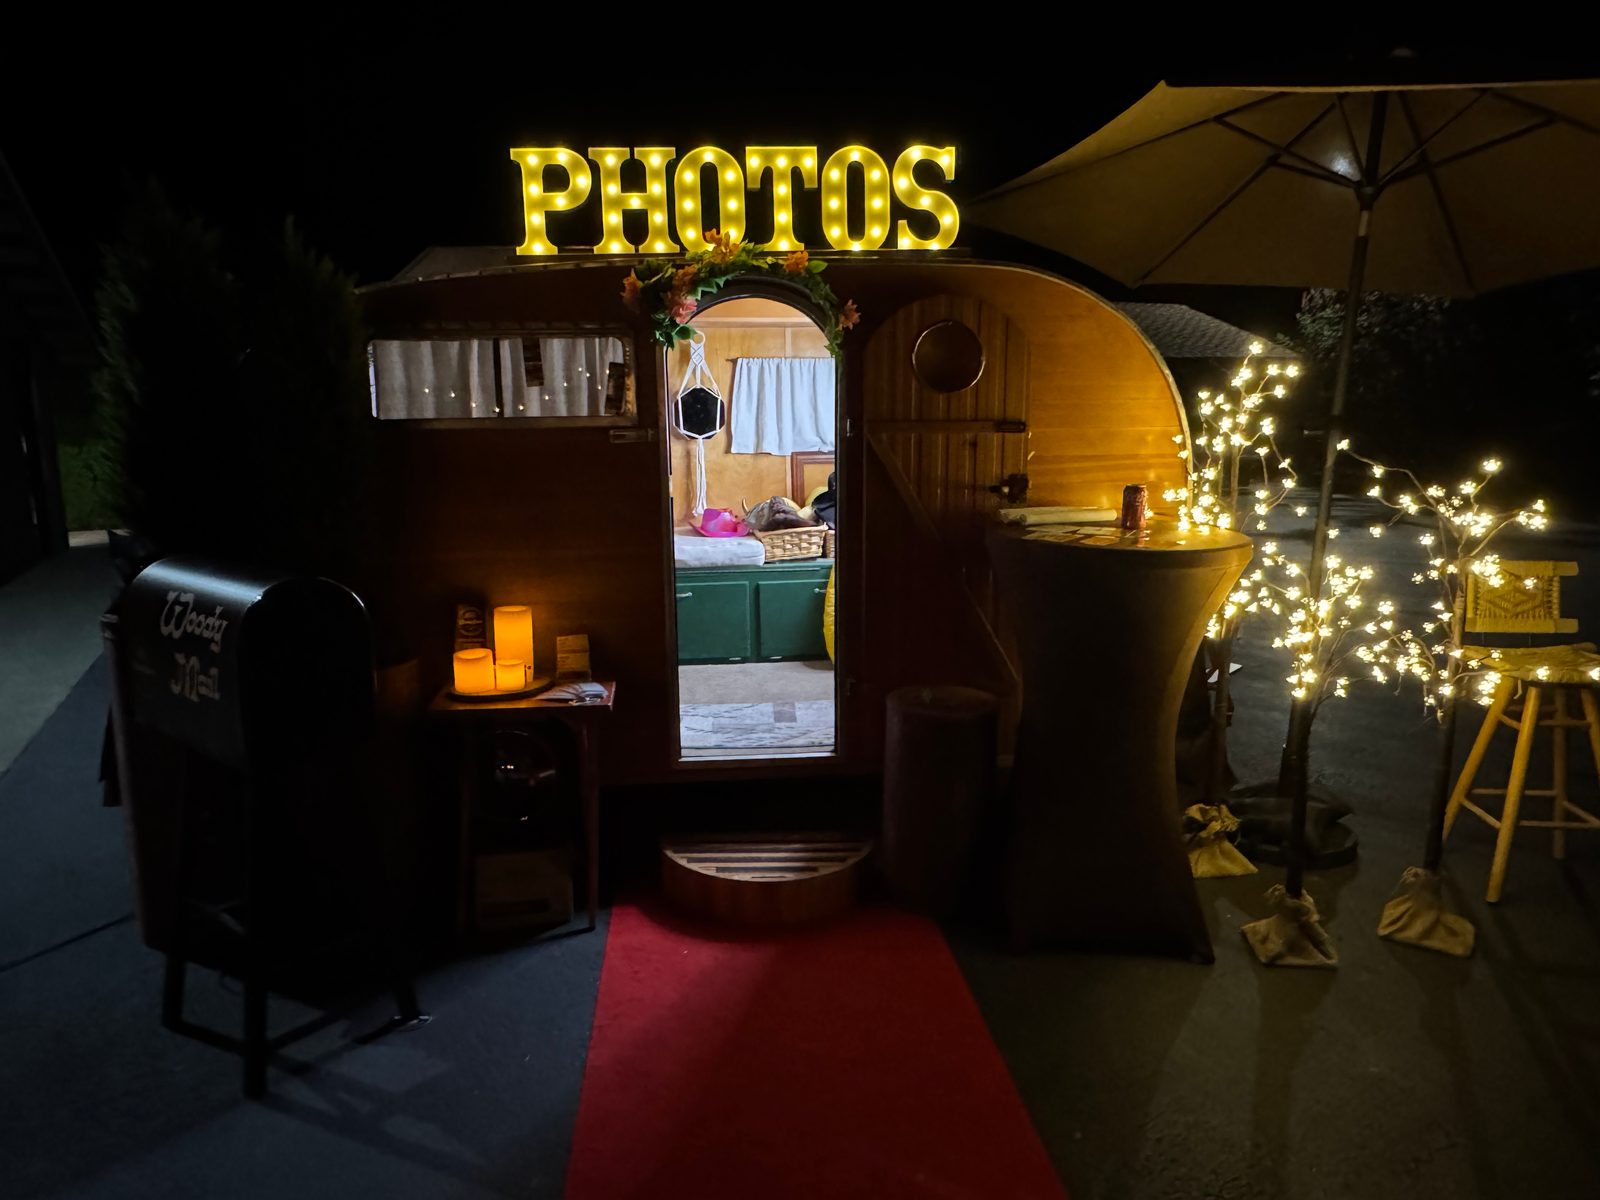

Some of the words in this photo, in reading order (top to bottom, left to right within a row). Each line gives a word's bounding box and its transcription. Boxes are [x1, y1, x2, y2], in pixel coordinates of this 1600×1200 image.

[509, 144, 961, 256] PHOTOS
[160, 590, 229, 653] Woody
[169, 652, 220, 702] Mail
